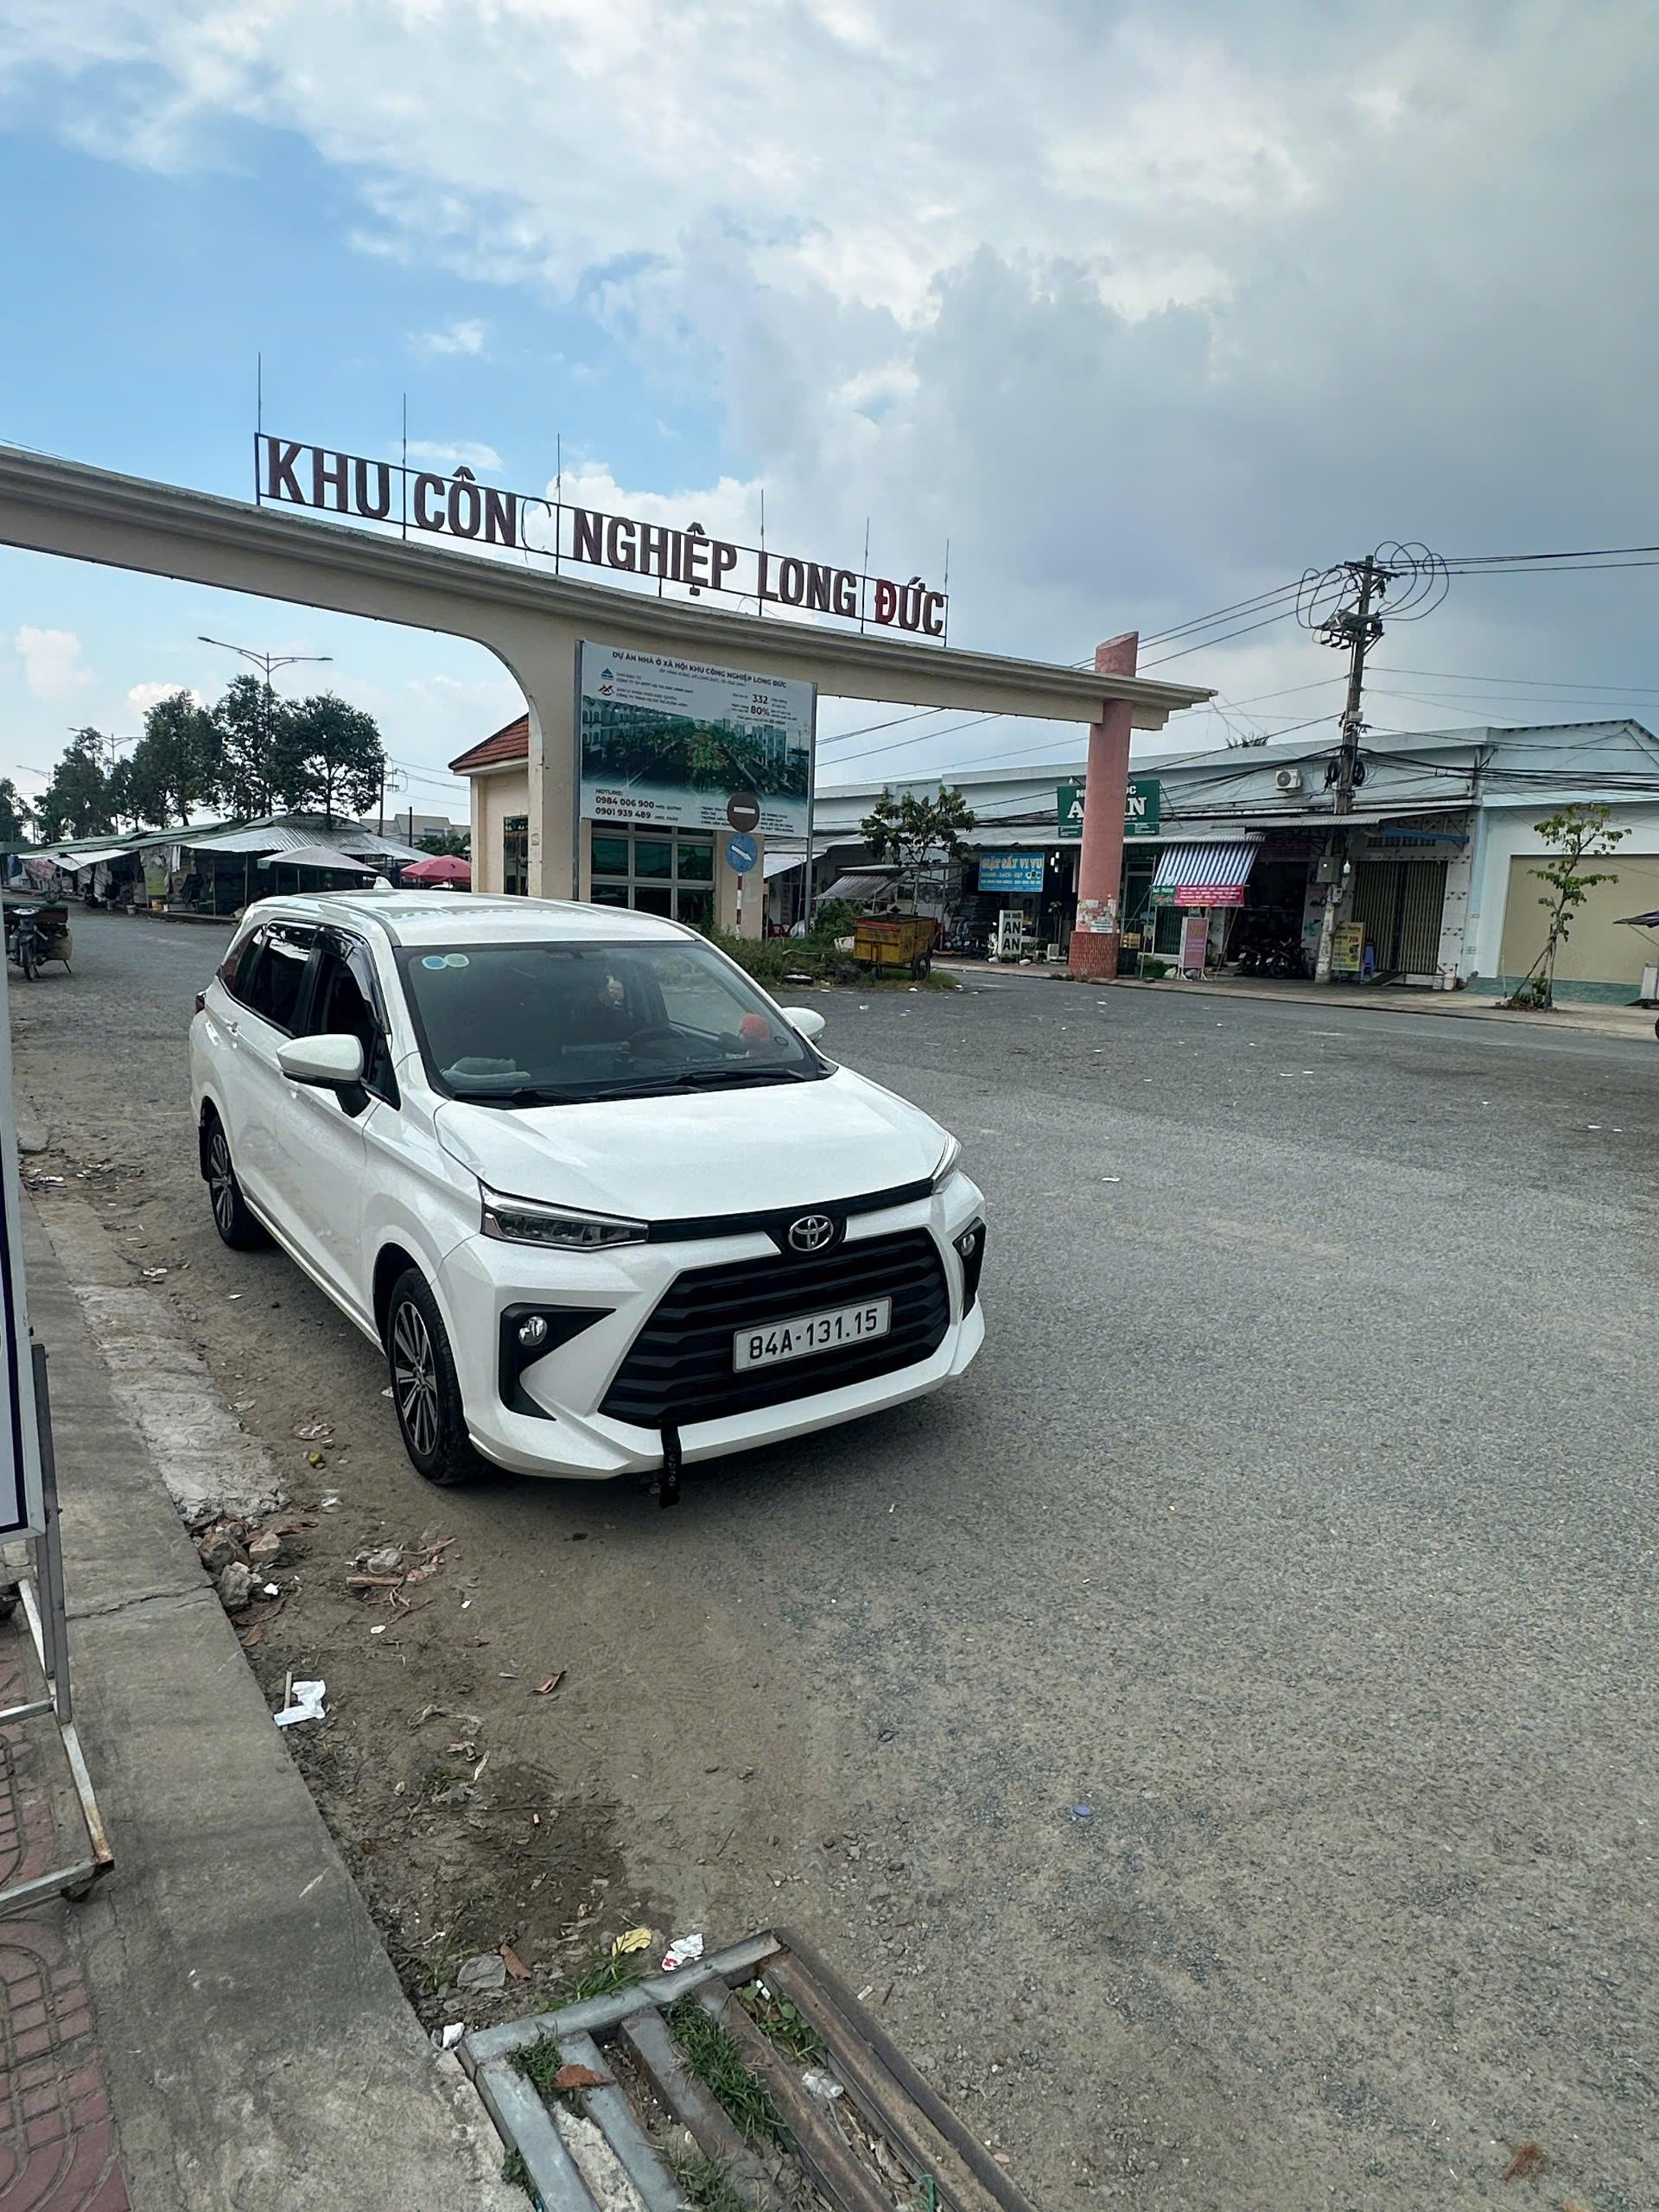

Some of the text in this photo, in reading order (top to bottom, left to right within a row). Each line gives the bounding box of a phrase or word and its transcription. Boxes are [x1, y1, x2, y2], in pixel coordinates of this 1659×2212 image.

[267, 436, 391, 518] KHU
[574, 507, 737, 596] NGHIỆP
[759, 551, 856, 616] LONG
[874, 576, 944, 635] ĐỨC
[753, 677, 772, 685] LONG
[752, 693, 768, 704] 332
[751, 705, 771, 716] 80%
[595, 796, 618, 805] 0984
[620, 798, 637, 807] 006
[639, 800, 654, 809] 900
[1004, 922, 1020, 933] AN
[1003, 938, 1020, 950] AN
[749, 1308, 878, 1360] 84A-131.15
